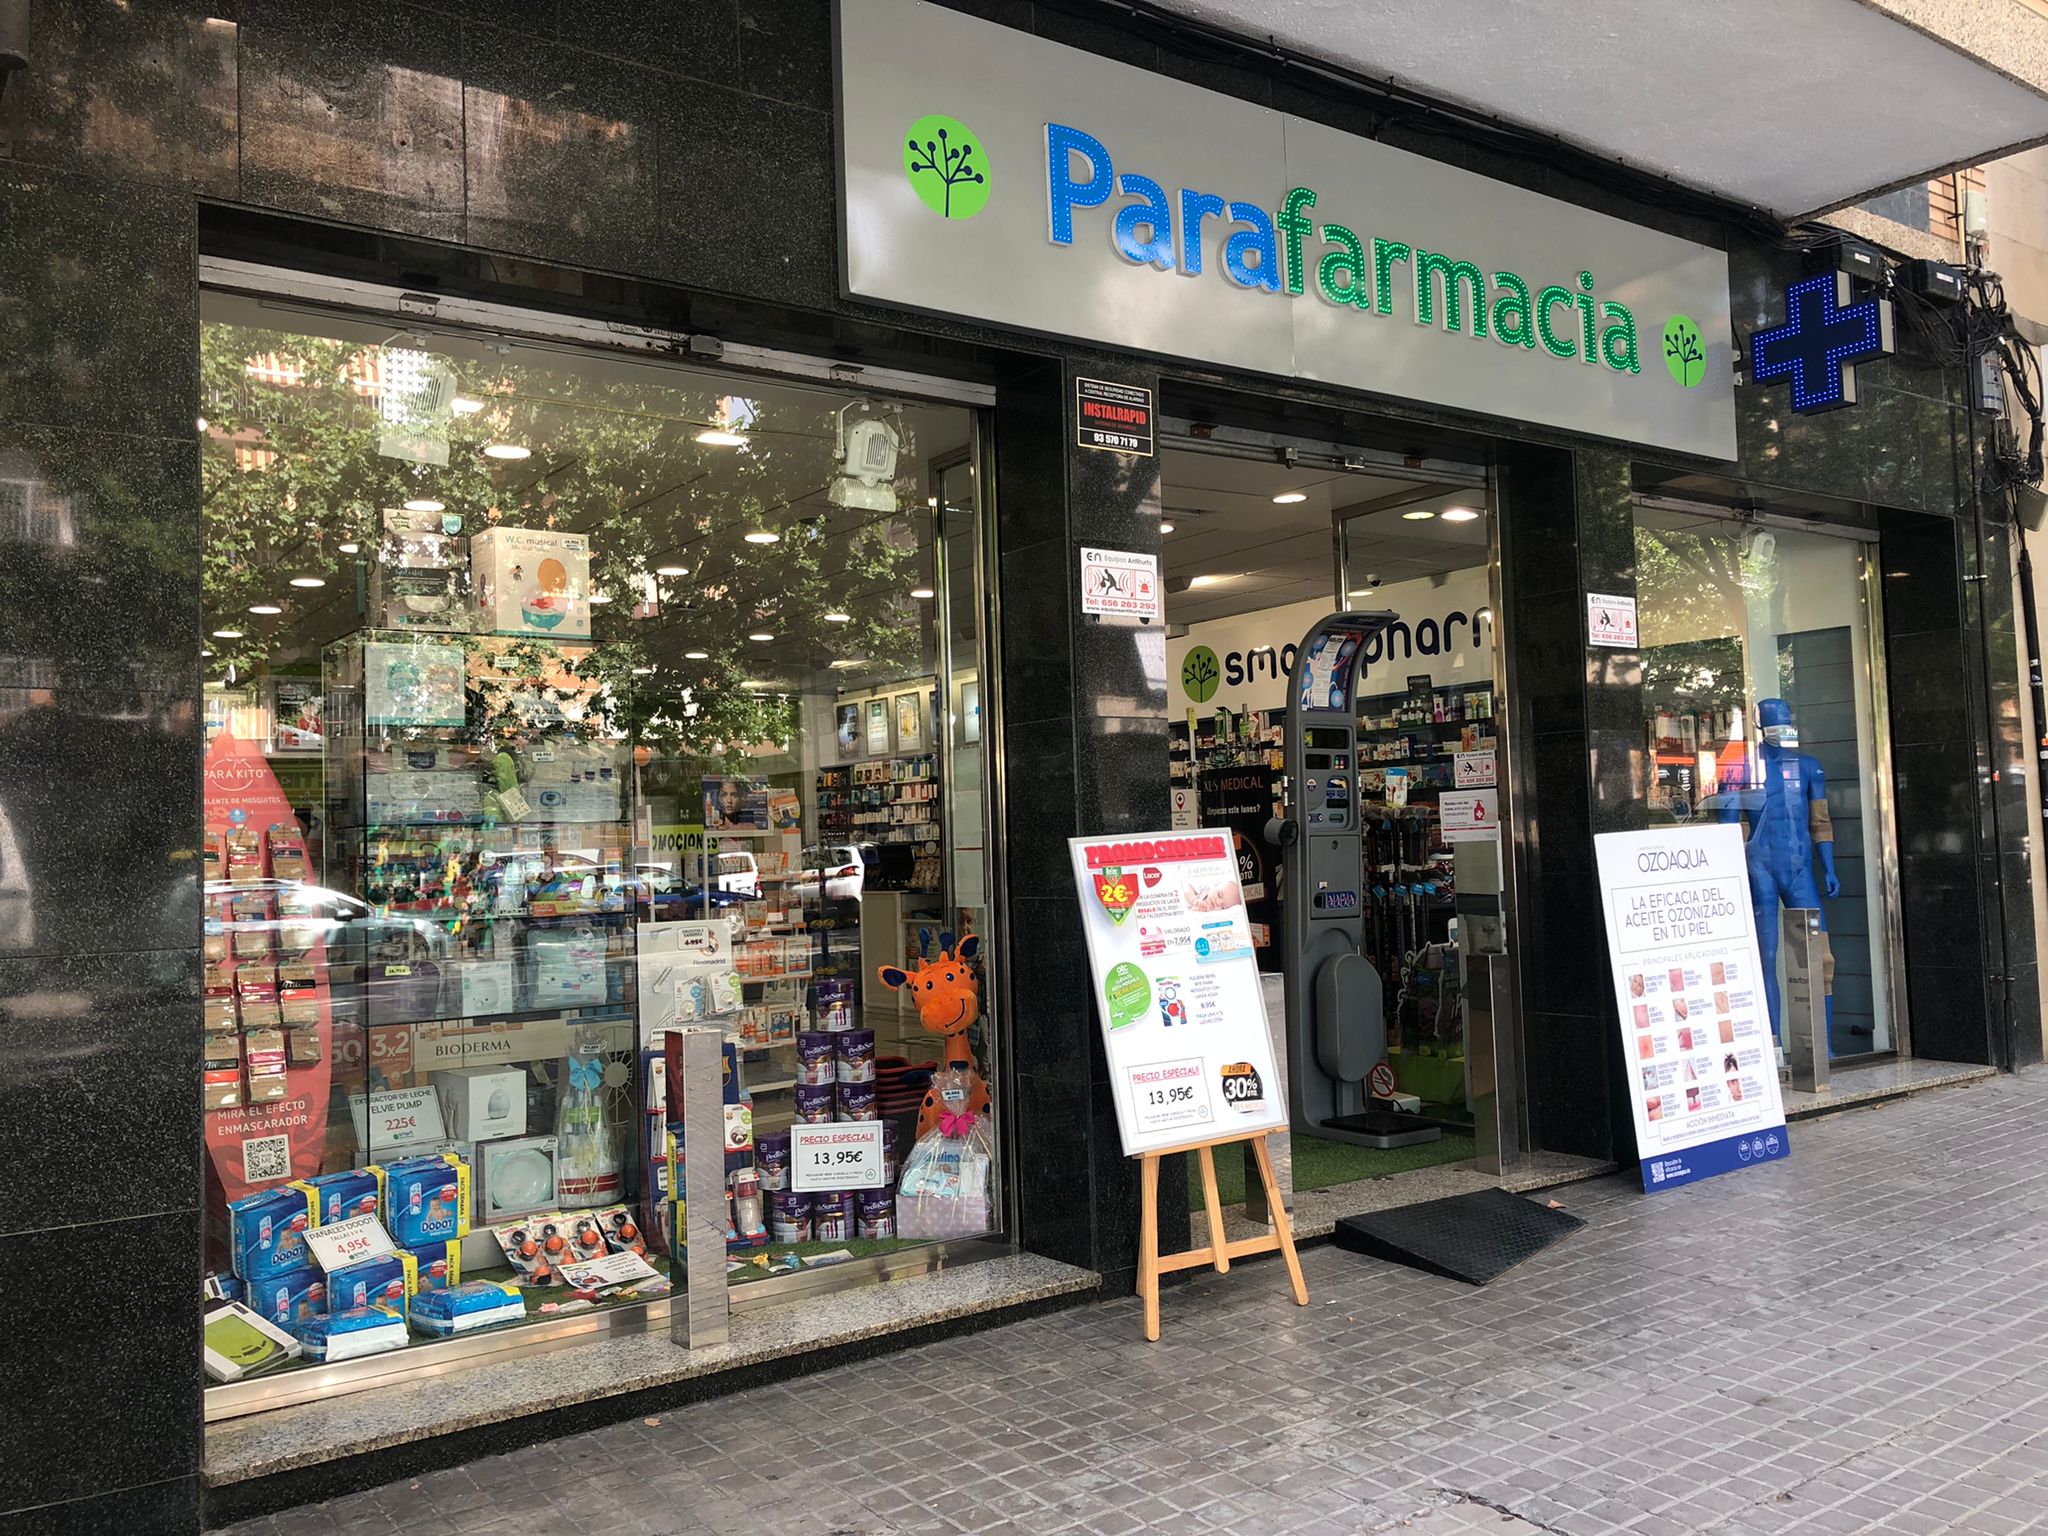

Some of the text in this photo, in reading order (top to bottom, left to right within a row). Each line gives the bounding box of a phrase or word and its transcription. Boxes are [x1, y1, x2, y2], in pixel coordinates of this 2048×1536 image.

[1043, 121, 1641, 374] Parafarmacia
[1083, 401, 1146, 425] INSTALRAPID
[1093, 433, 1104, 443] 93
[1105, 434, 1120, 445] 570
[1120, 436, 1128, 446] 71
[1129, 438, 1138, 448] 79
[526, 537, 558, 547] musical
[1104, 555, 1126, 563] Equipos
[1127, 558, 1153, 566] Antihurto
[1102, 599, 1119, 607] 656
[1121, 601, 1138, 609] 283
[1140, 602, 1156, 610] 293
[1220, 776, 1264, 791] MEDICAL
[241, 796, 281, 804] MOSQUITOS
[1637, 848, 1709, 873] OZOAQUA
[1143, 871, 1162, 880] Lacer
[1630, 887, 1725, 911] LA EFICACIA DEL
[1625, 901, 1736, 929] ACEITE OZONIZADO
[1652, 921, 1713, 942] EN TU PIEL
[371, 1031, 410, 1058] 3x2
[435, 1039, 512, 1057] BIODERMA
[1132, 1071, 1161, 1082] PRECIO
[410, 1089, 433, 1099] LECHE
[1149, 1086, 1194, 1106] 13,95€
[1224, 1078, 1258, 1100] 30%
[217, 1100, 306, 1121] MIRA EL EFECTO
[371, 1100, 423, 1114] ELVIE PUMP
[218, 1114, 308, 1136] ENMASCARADOR
[385, 1116, 417, 1131] 225€
[1686, 1115, 1708, 1130] ACCIÓN
[1708, 1109, 1736, 1125] INMEDIATA
[800, 1135, 830, 1144] PRECIO
[814, 1151, 863, 1167] 13,95€
[308, 1216, 375, 1240] PAÑALES DODOT
[421, 1219, 454, 1233] DODOT
[330, 1232, 351, 1241] TALLAS
[337, 1236, 371, 1255] 4,95€
[271, 1245, 305, 1266] DODOT
